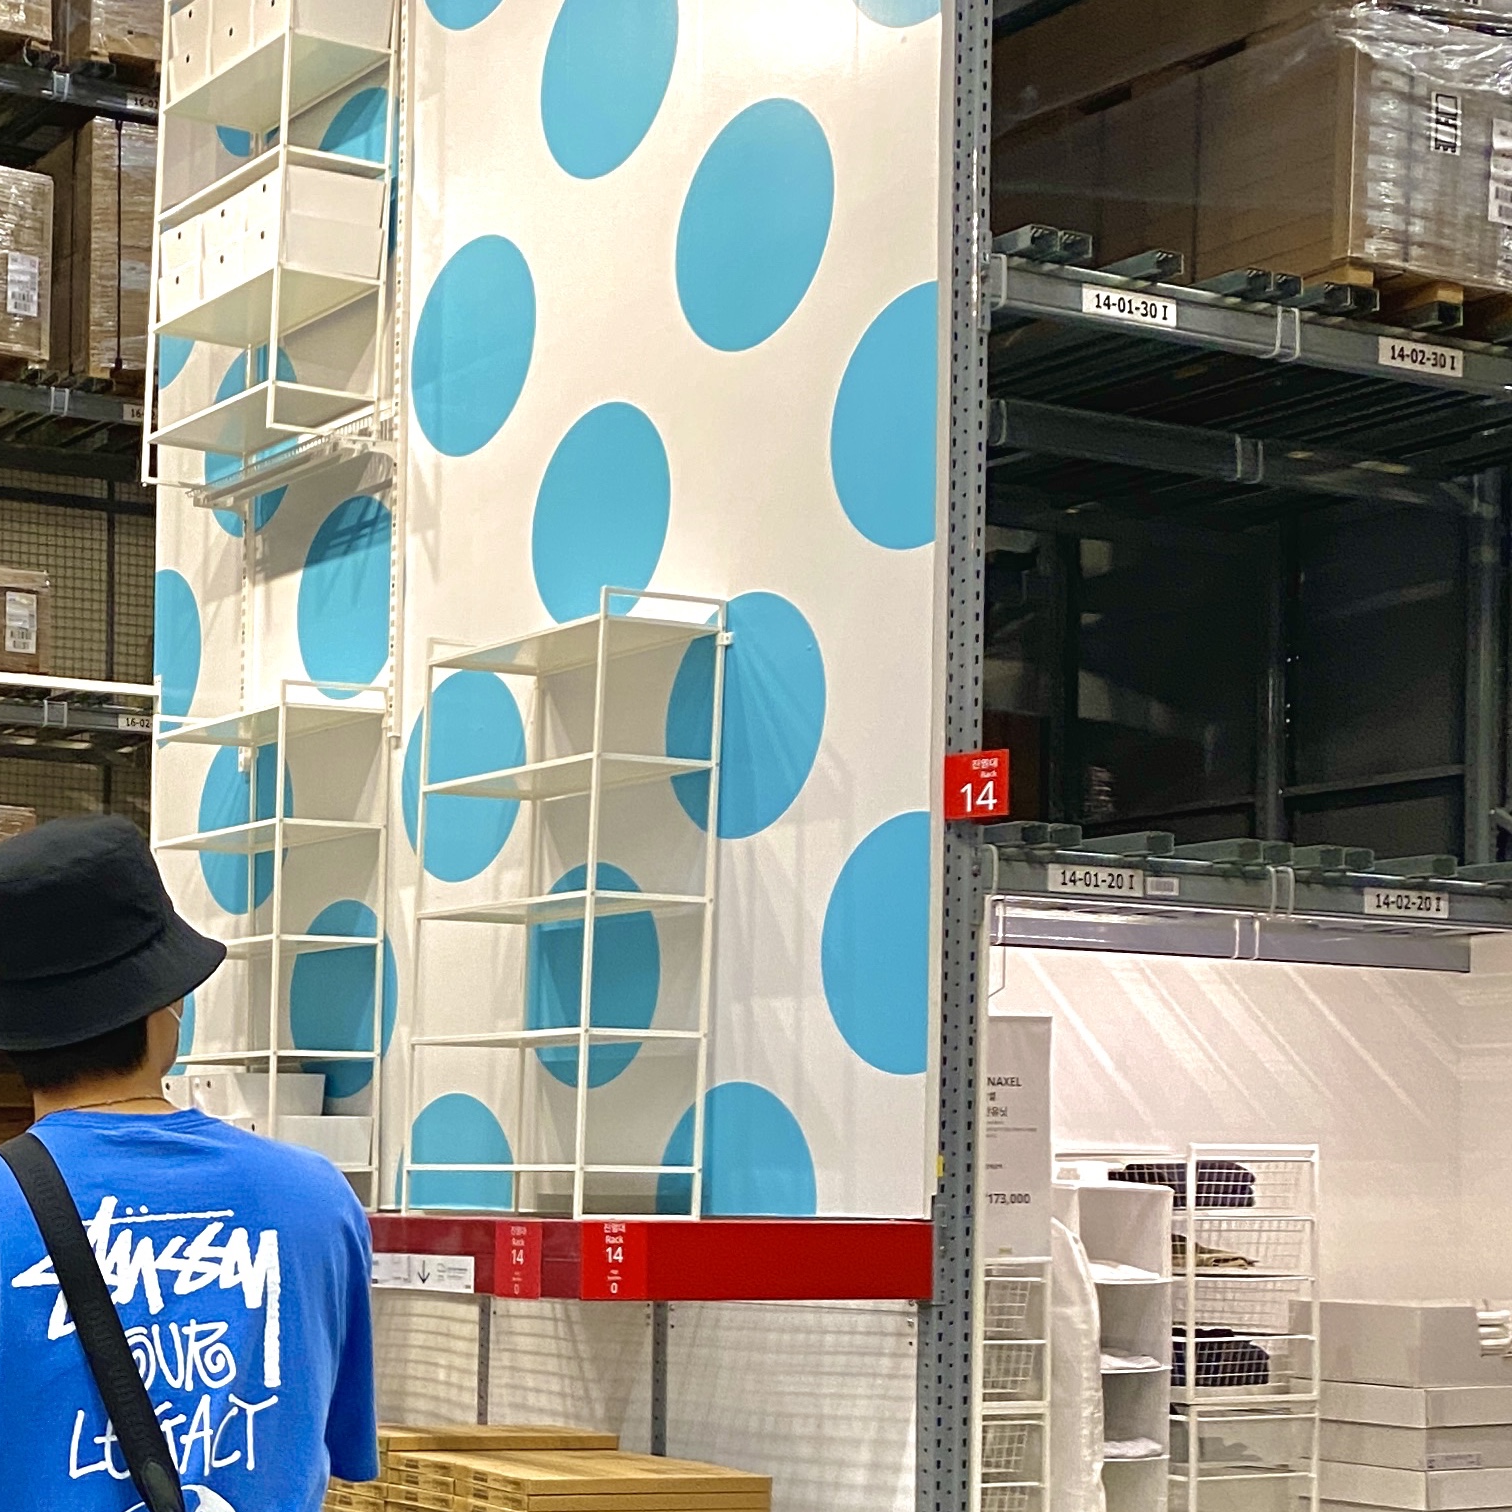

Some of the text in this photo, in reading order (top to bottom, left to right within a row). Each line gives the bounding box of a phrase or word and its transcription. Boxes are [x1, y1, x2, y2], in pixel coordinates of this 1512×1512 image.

[1095, 293, 1157, 319] 14-01-30
[1391, 344, 1447, 369] 14-02-30
[960, 780, 998, 813] 14
[1061, 869, 1124, 889] 14-01-20
[1376, 893, 1432, 912] 14-02-20
[987, 1076, 1022, 1087] NAXEL
[986, 1193, 1031, 1206] 173,000
[511, 1249, 525, 1266] 14
[605, 1246, 624, 1264] 14
